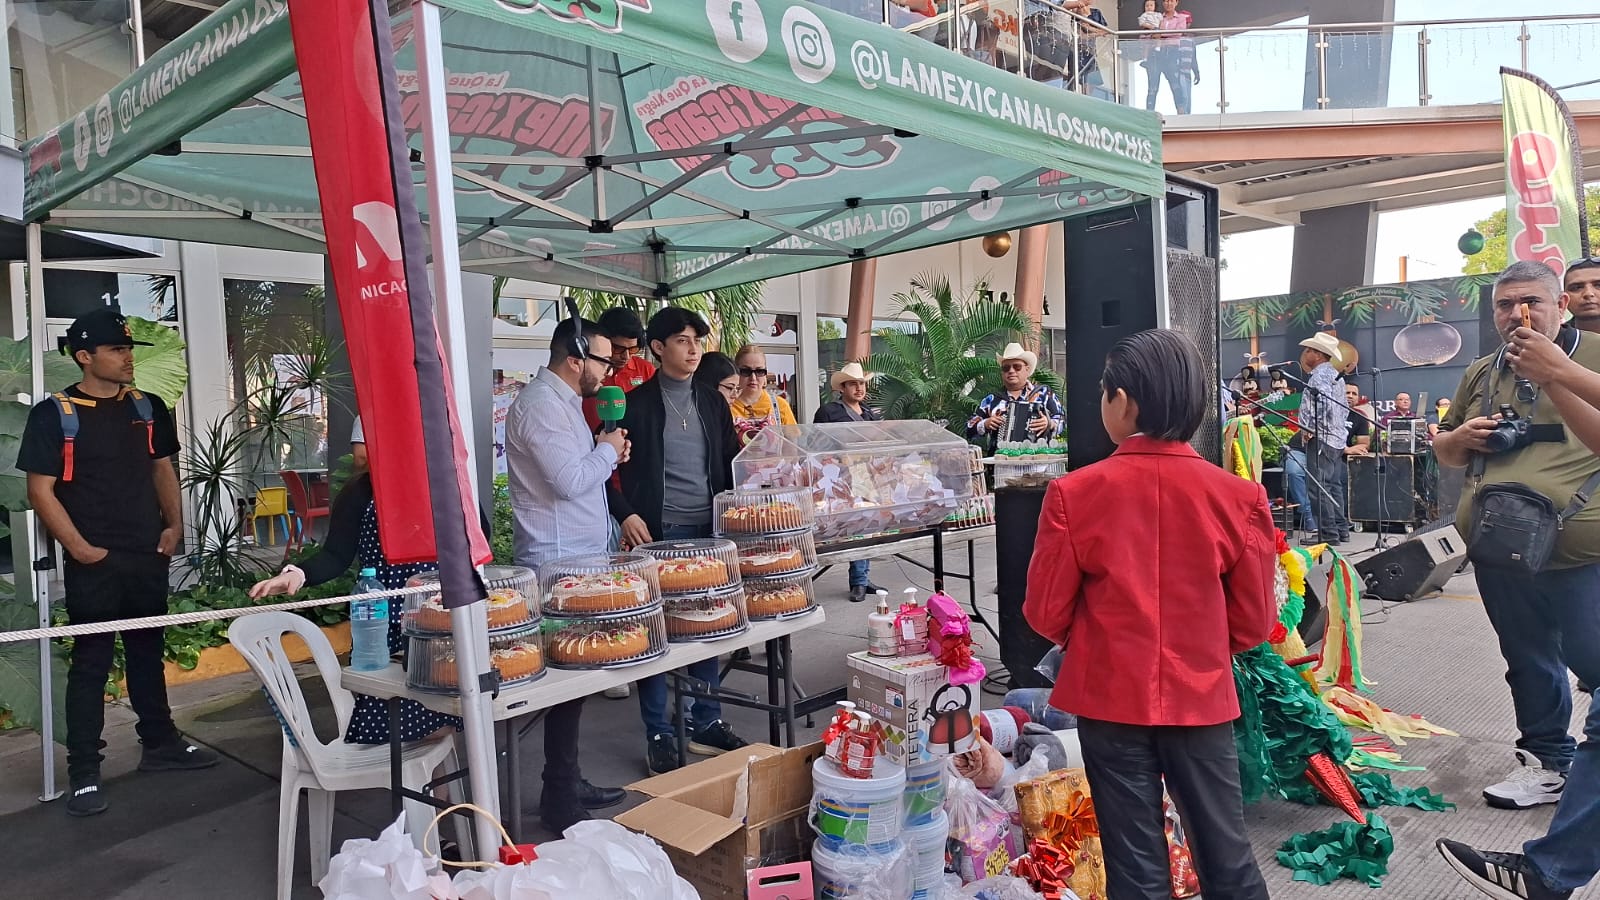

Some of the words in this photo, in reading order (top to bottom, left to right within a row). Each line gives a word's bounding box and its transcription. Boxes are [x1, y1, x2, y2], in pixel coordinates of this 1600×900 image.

[850, 39, 1153, 164] @LAMEXICANALOSMOCHIS
[908, 699, 919, 765] TETERA
[74, 785, 98, 797] PUMA
